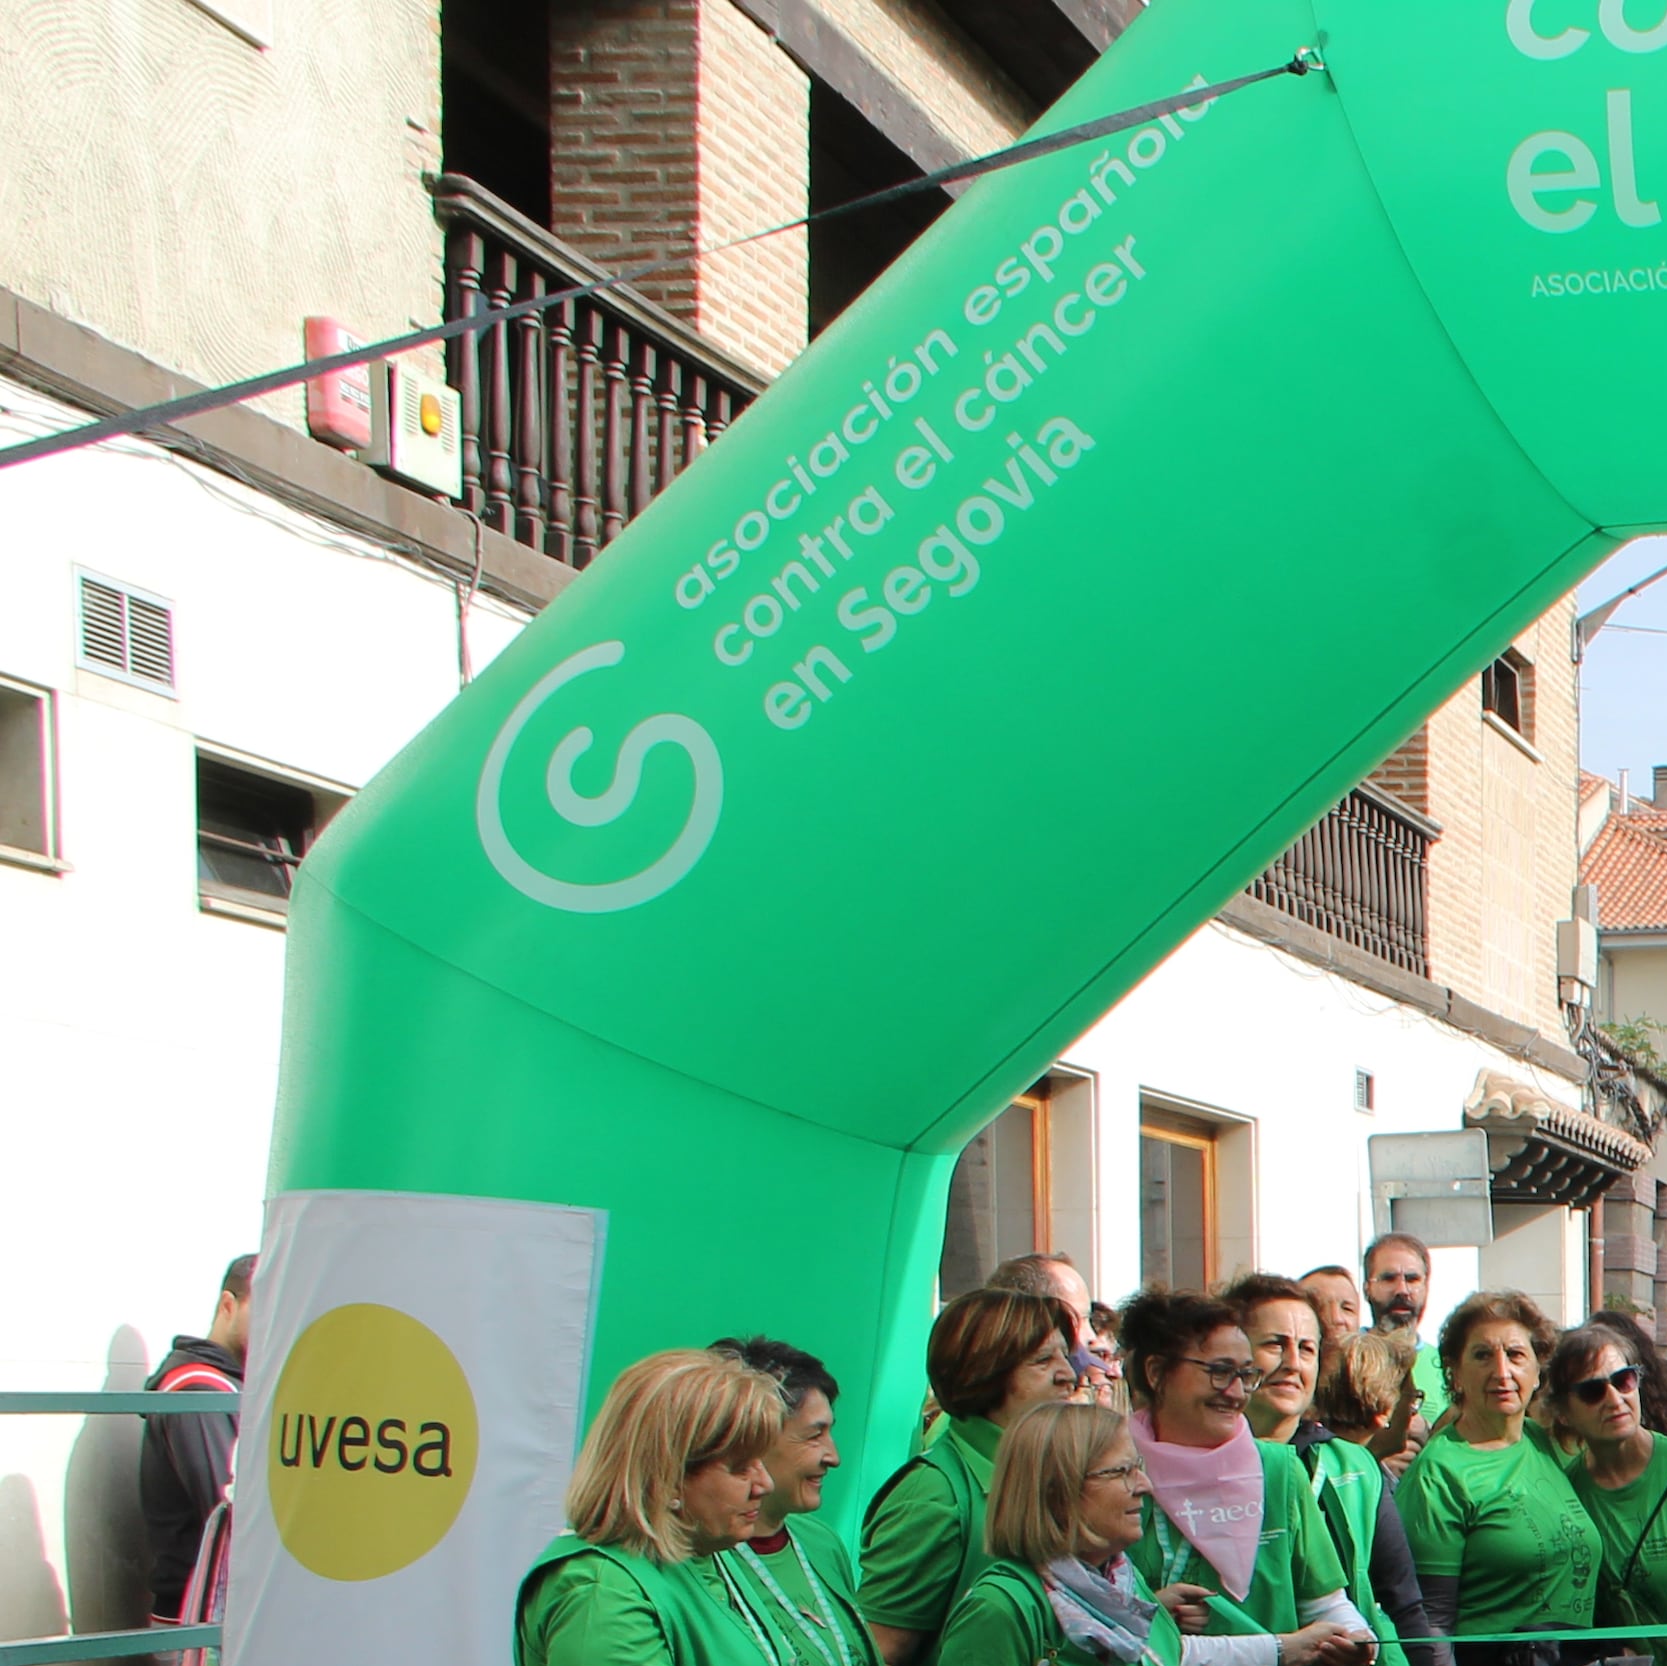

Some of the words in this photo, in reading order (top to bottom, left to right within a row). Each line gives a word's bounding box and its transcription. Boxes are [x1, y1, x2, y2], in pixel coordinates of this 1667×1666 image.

[1506, 88, 1662, 234] el
[674, 327, 959, 611] asociación
[964, 72, 1221, 327] española
[713, 484, 896, 666] contra
[895, 416, 955, 490] el
[955, 233, 1147, 432] cáncer
[763, 646, 854, 731] en
[837, 413, 1098, 653] Segovia
[278, 1410, 452, 1478] uvesa
